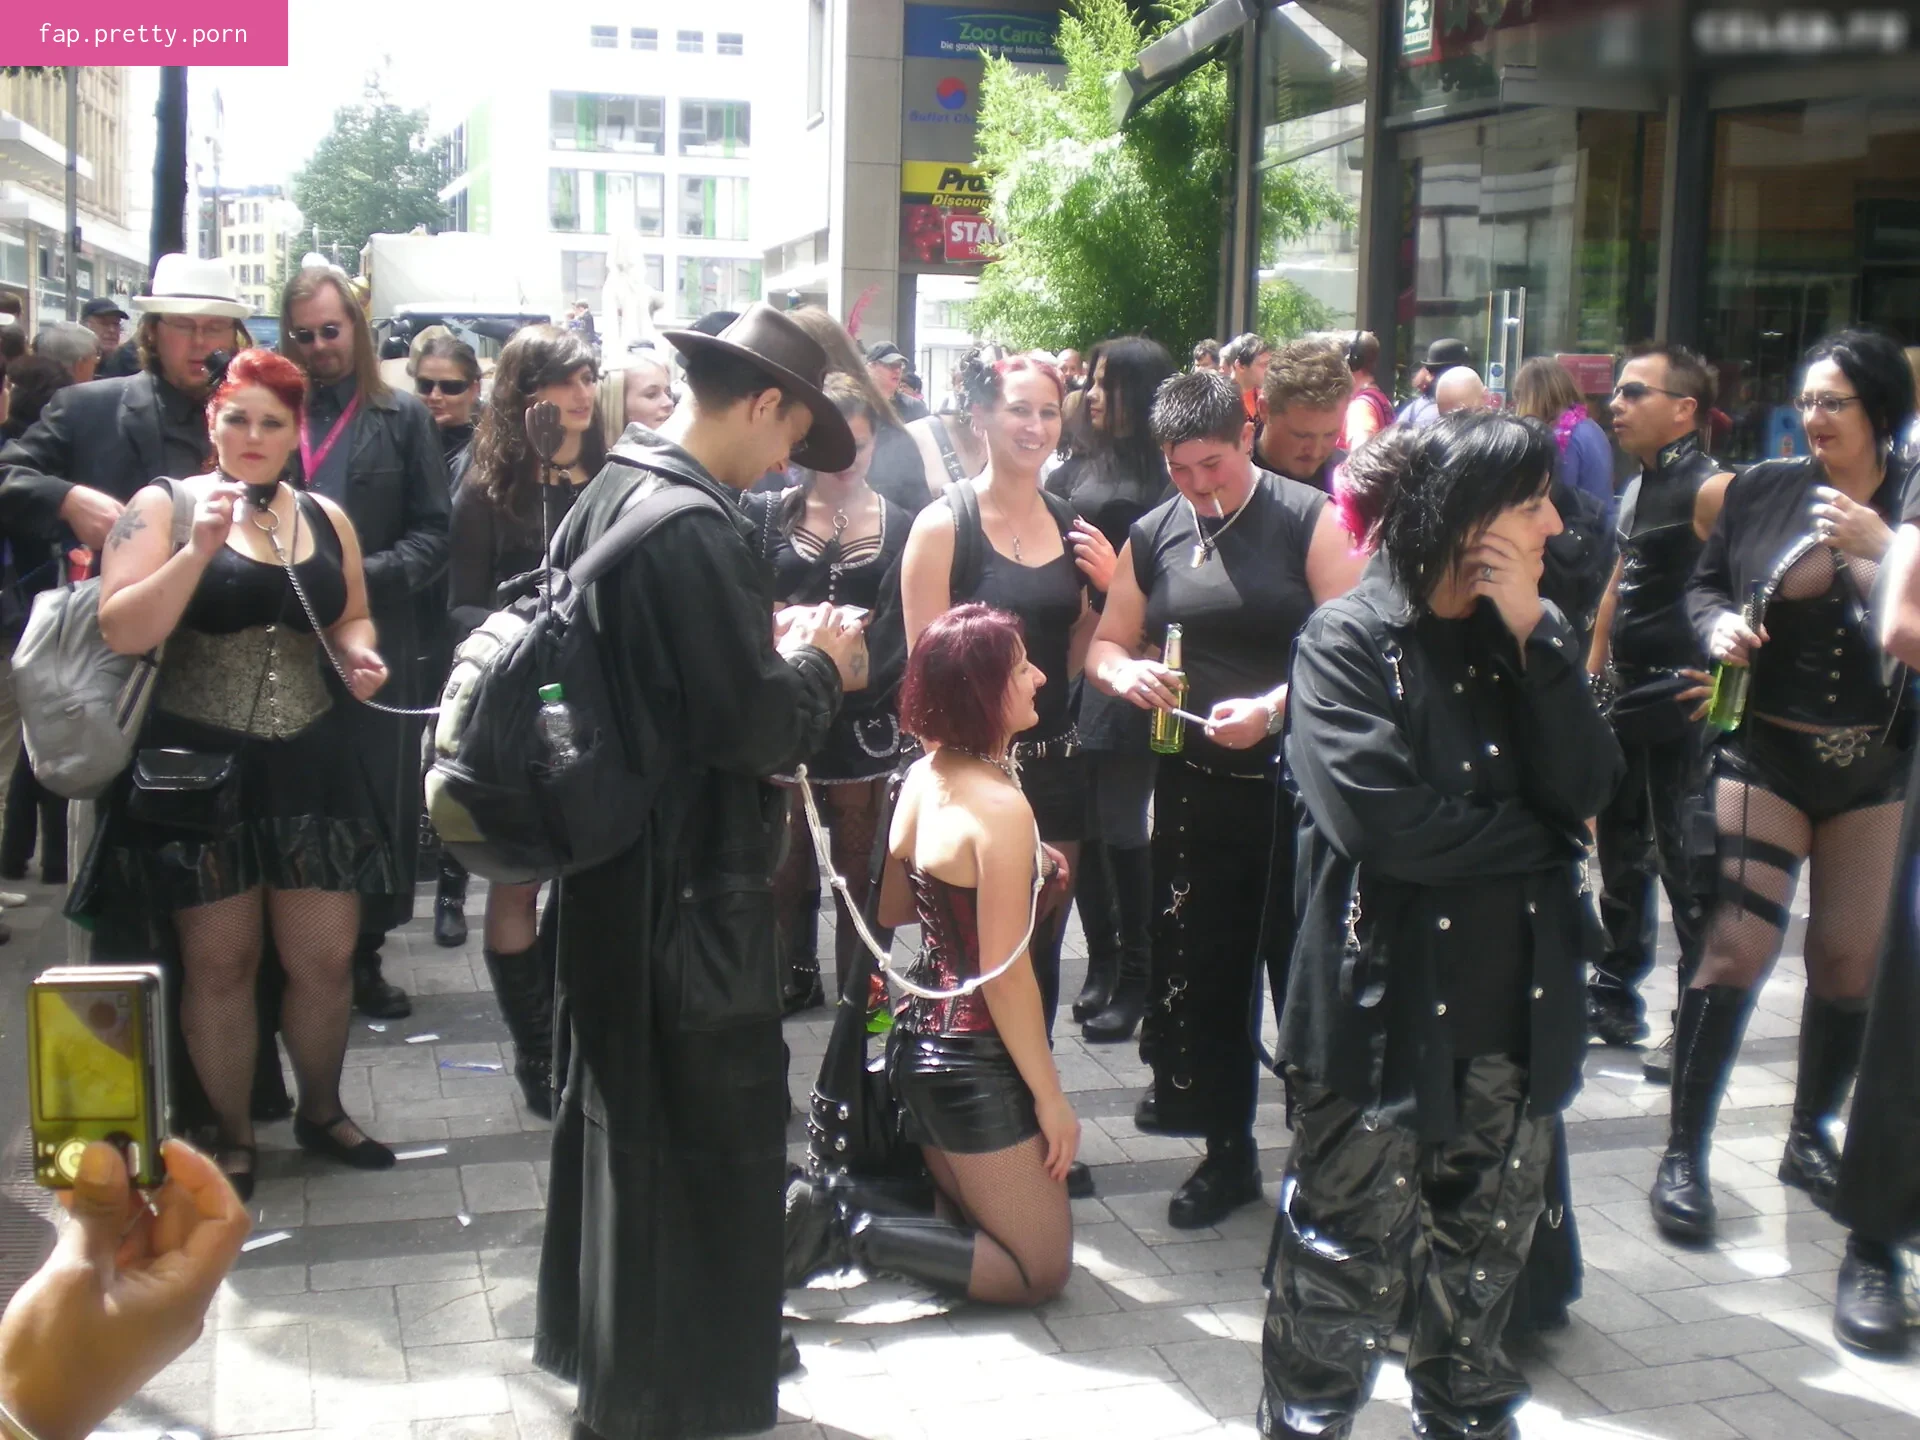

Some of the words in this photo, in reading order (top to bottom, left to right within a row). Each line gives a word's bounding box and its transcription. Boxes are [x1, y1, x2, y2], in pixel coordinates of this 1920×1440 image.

[960, 22, 996, 41] Zoo
[941, 41, 954, 50] Die
[932, 194, 992, 208] Discoun
